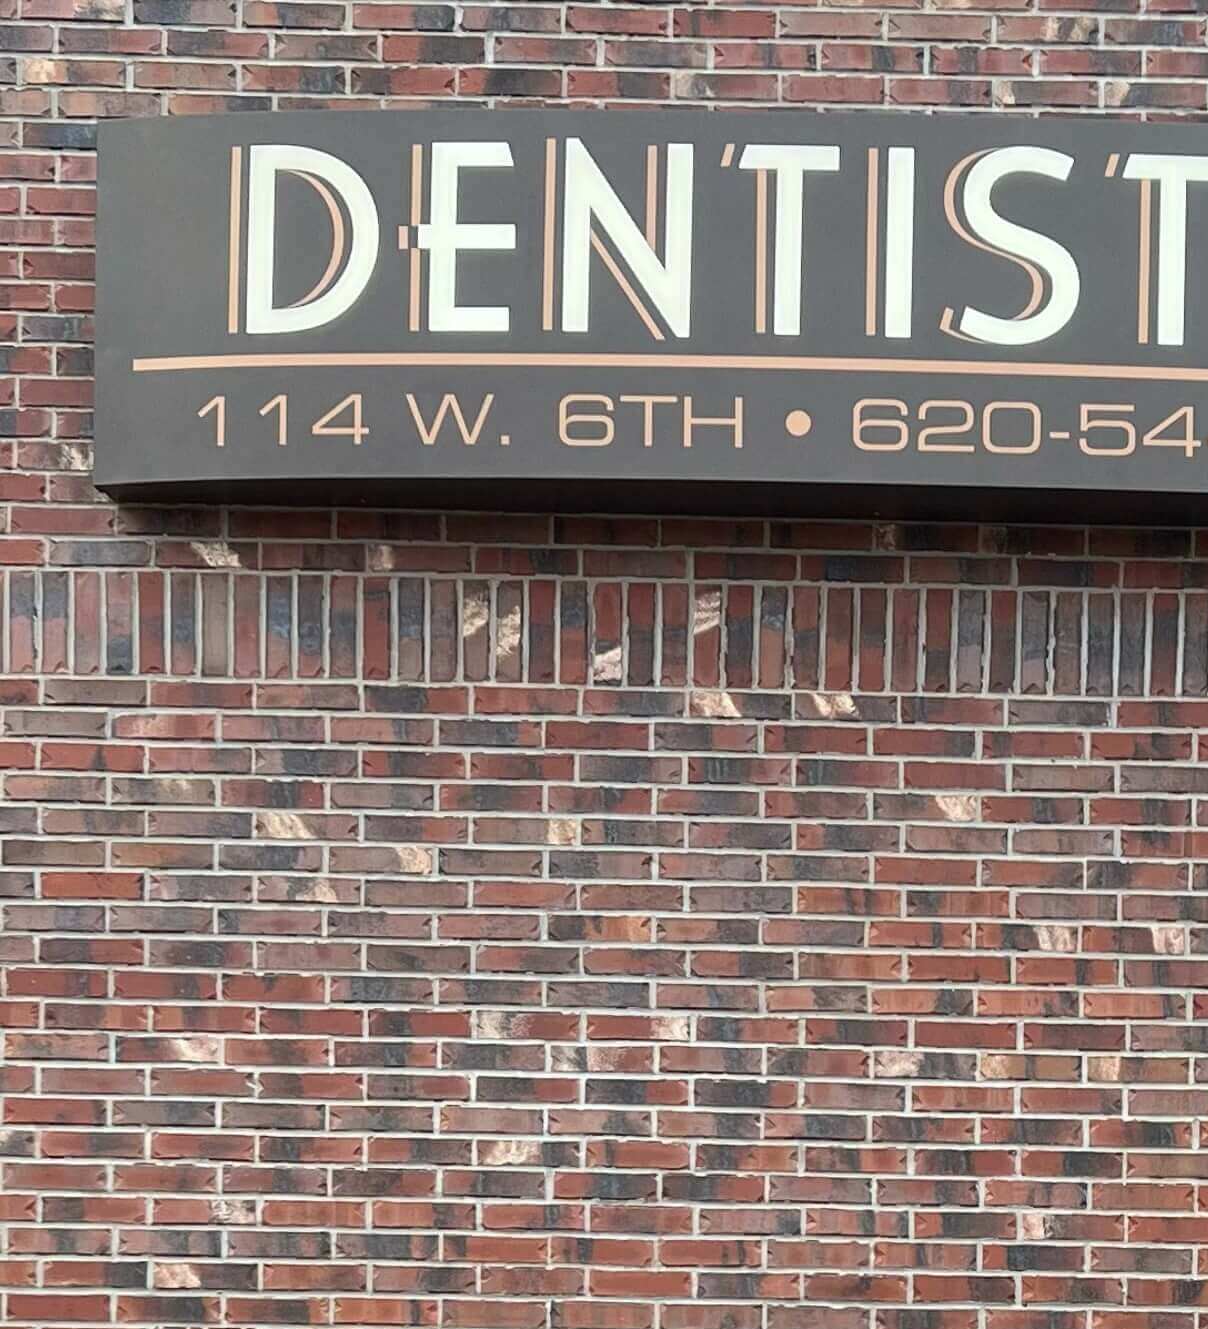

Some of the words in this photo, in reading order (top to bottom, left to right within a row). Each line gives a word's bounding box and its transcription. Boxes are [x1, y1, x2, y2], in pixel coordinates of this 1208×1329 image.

[197, 393, 370, 447] 114
[405, 393, 510, 446] W.
[558, 393, 743, 449] 6TH
